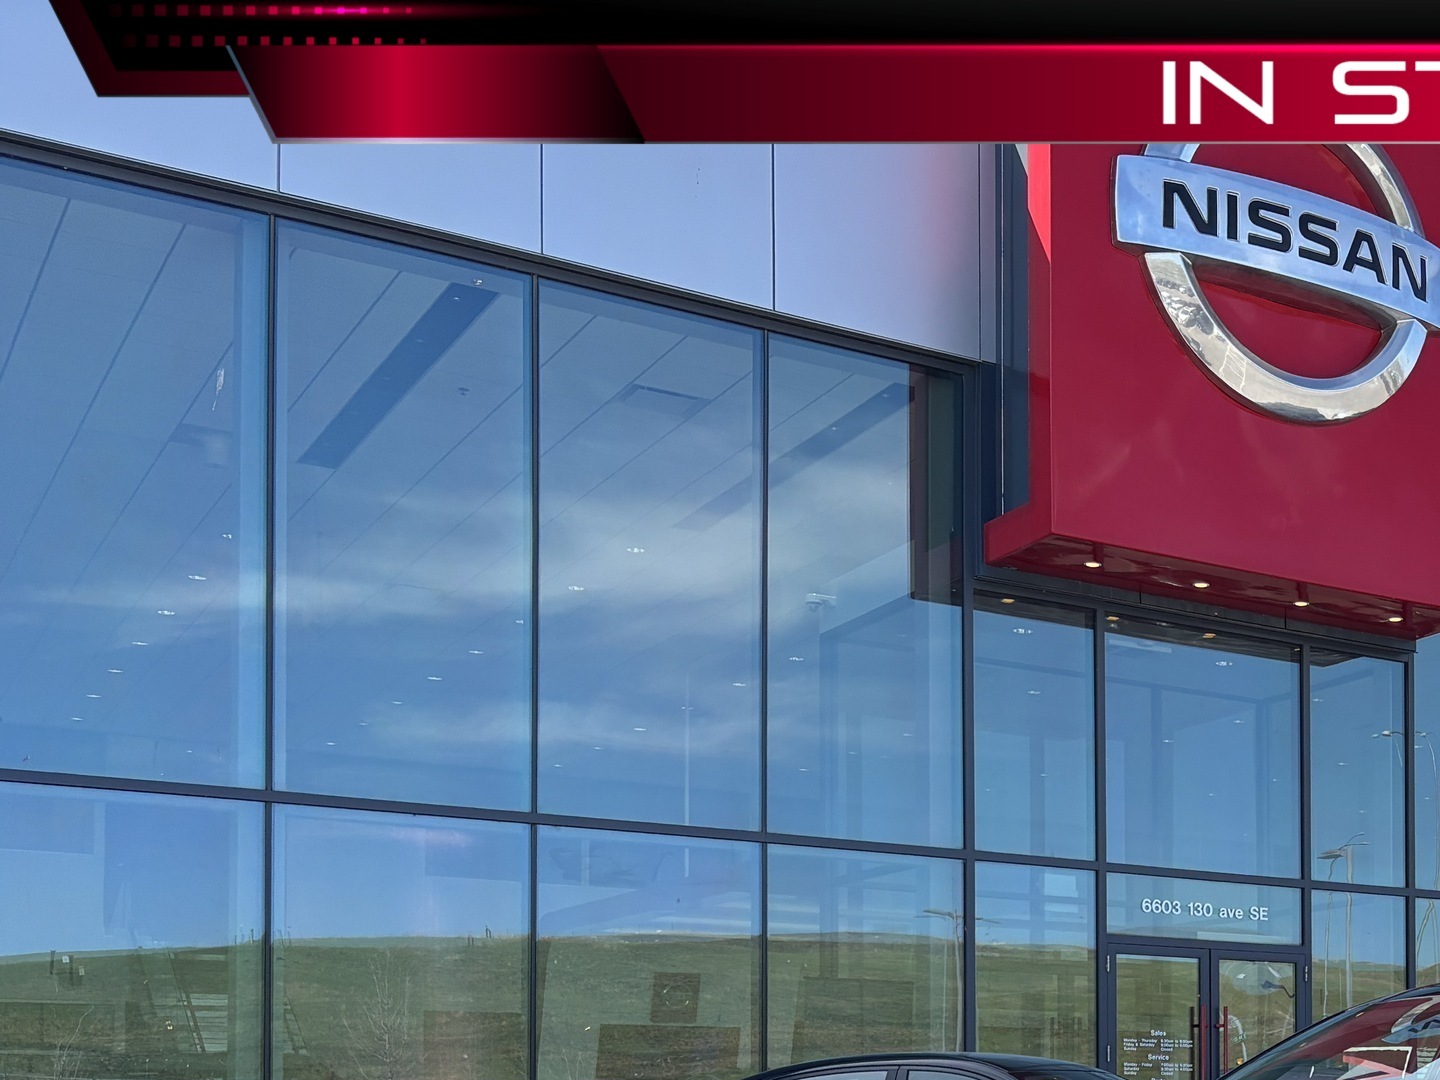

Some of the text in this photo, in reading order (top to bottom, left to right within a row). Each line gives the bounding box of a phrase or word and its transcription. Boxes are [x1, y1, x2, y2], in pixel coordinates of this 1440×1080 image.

[1161, 178, 1430, 304] NISSAN
[1141, 898, 1269, 921] 6603 130 ave SE
[1150, 1029, 1167, 1037] Sales
